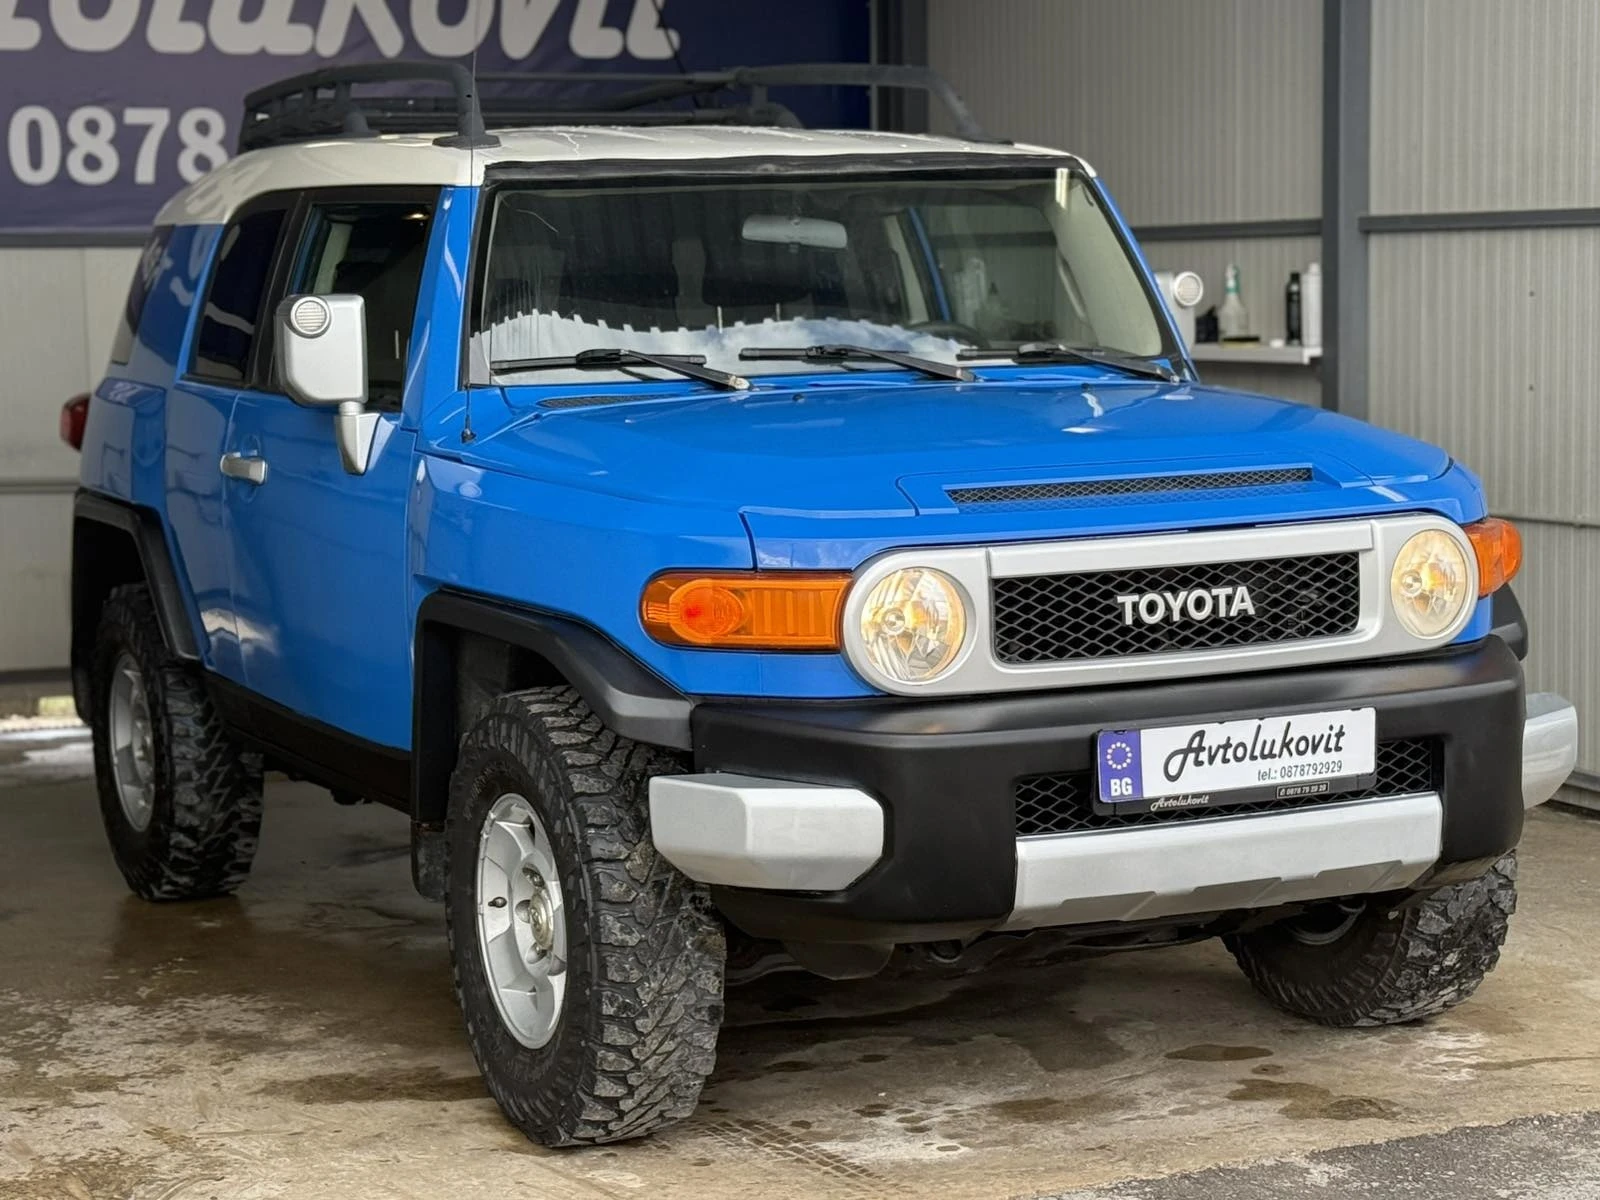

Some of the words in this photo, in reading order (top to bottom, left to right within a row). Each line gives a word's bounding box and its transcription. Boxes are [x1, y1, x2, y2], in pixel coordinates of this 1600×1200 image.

[8, 105, 229, 186] 0878
[1117, 586, 1255, 625] TOYOTA
[1163, 721, 1346, 783] Avtolukovit
[1280, 760, 1343, 779] 0878792929
[1110, 777, 1133, 797] BG
